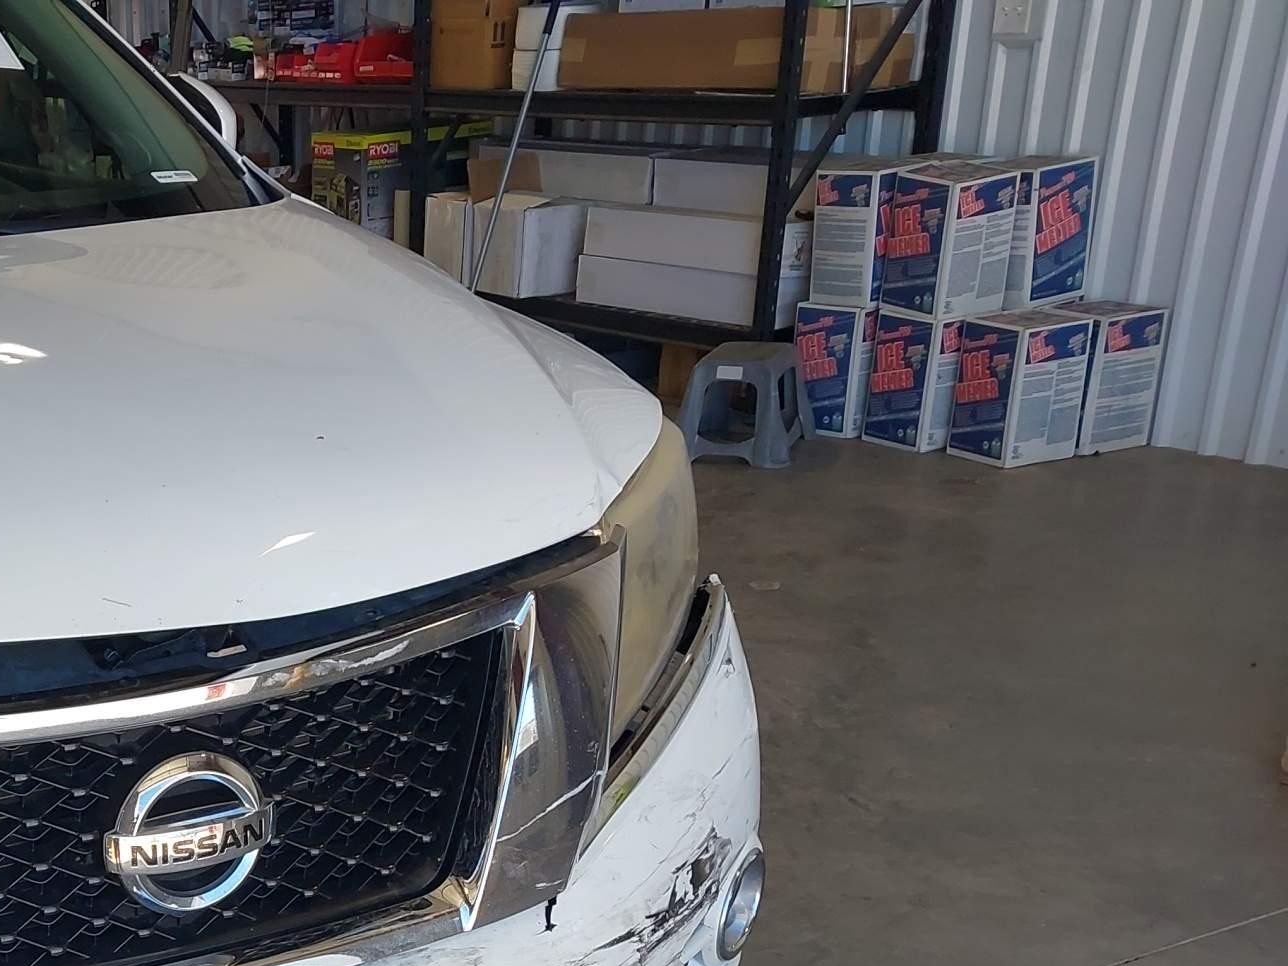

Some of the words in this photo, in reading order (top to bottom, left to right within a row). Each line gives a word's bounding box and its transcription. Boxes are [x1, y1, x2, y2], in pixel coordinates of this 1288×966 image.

[369, 142, 399, 159] RYOBI
[894, 204, 922, 237] ICE
[1039, 188, 1074, 231] ICE
[887, 232, 931, 259] MELTER
[1035, 212, 1081, 254] MELTER
[796, 331, 828, 361] ICE
[877, 340, 906, 373] ICE
[962, 349, 992, 383] ICE
[130, 819, 265, 868] NISSAN
